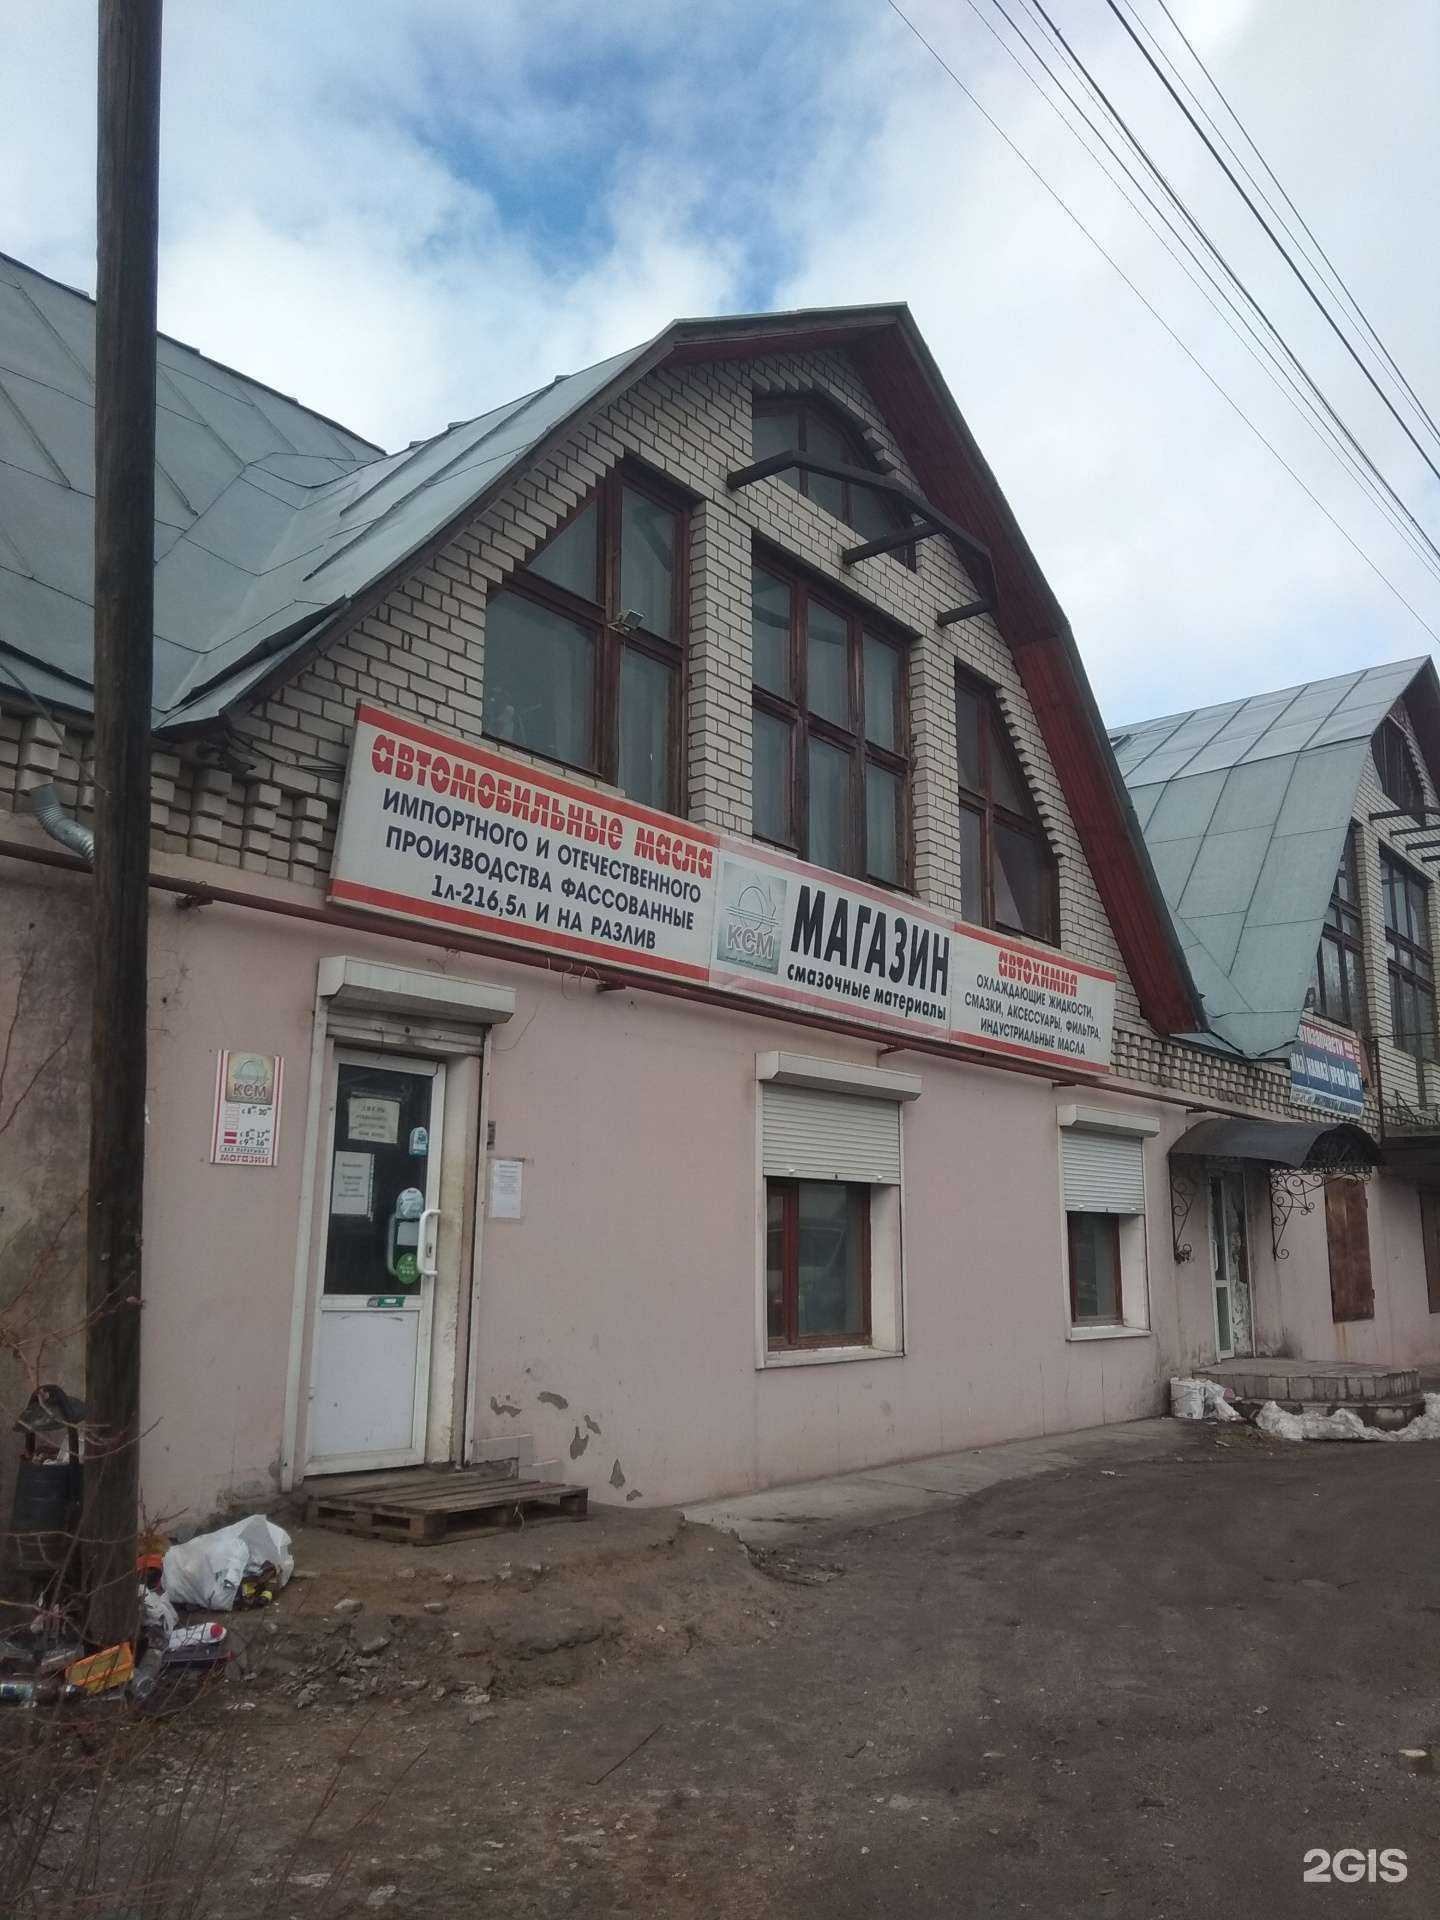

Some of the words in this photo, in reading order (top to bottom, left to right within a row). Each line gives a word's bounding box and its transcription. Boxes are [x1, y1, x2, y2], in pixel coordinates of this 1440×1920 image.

[383, 788, 528, 851] ИМПОРТНОГО
[536, 837, 550, 859] И
[558, 845, 701, 903] ОТЕЧЕСТВЕННОГО
[386, 825, 552, 892] ПРОИЗВОДСТВА
[561, 878, 694, 930] ФАССОВАННЫЕ
[536, 902, 550, 923] И
[557, 908, 582, 932] НА
[591, 916, 656, 949] РАЗЛИВ
[790, 884, 950, 996] МАГАЗИН
[787, 964, 871, 1000] смазочные
[873, 987, 946, 1020] материалы
[964, 992, 1004, 1017] СМАЗКИ,
[1007, 1004, 1062, 1032] АКСЕССУАРЫ,
[976, 974, 1046, 1006] ОХЛАЖДАЮЩИЕ
[1048, 996, 1094, 1020] ЖИДКОСТИ,
[980, 1018, 1055, 1048] ИНДУСТРИАЛЬНЫЕ
[1058, 1038, 1085, 1055] МАСЛА
